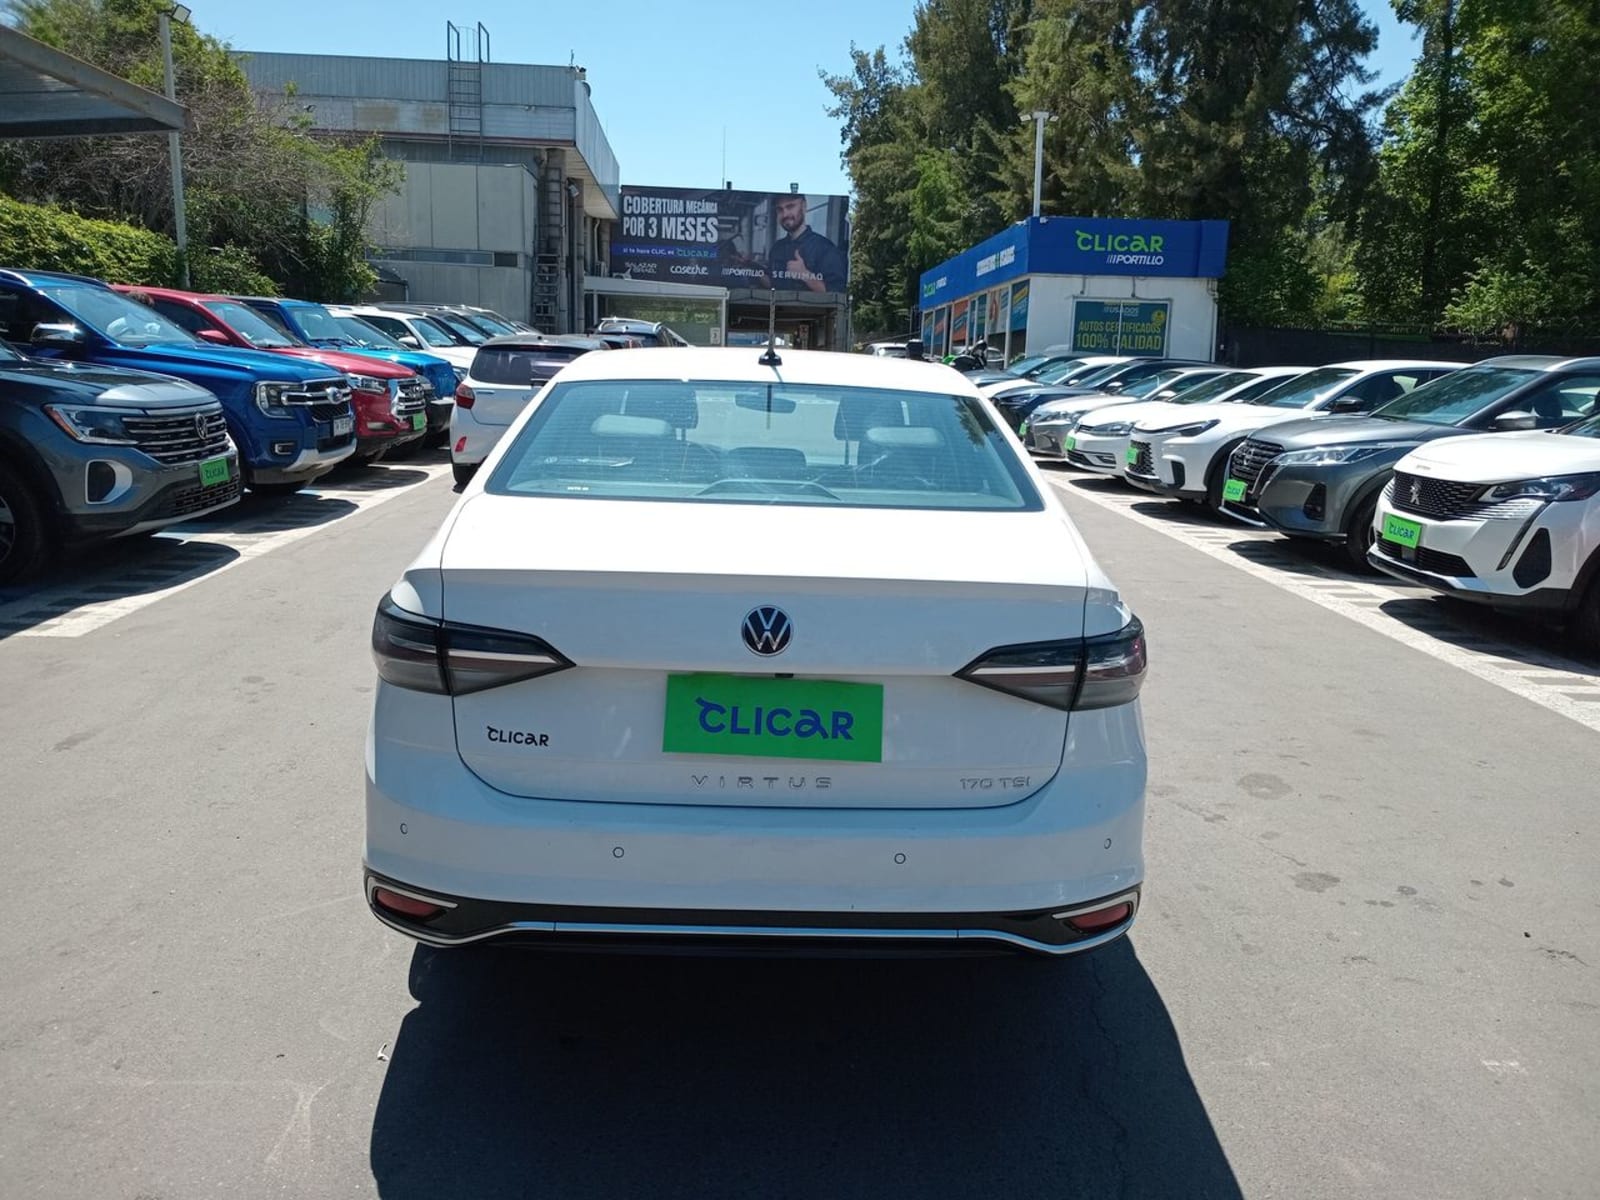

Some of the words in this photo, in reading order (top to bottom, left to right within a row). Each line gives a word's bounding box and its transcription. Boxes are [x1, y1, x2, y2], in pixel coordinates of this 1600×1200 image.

[623, 196, 684, 215] COBERTURA
[623, 216, 645, 237] POR
[648, 216, 658, 238] 3
[661, 216, 719, 243] MESES
[1115, 254, 1164, 266] PORTILLO
[729, 267, 765, 278] PORTILLO
[1079, 320, 1104, 332] AUTOS
[1077, 333, 1109, 348] 100%
[1111, 334, 1162, 350] CALIDAD
[691, 774, 832, 789] VIRTUS
[960, 777, 993, 790] 170
[998, 775, 1031, 789] TSI
